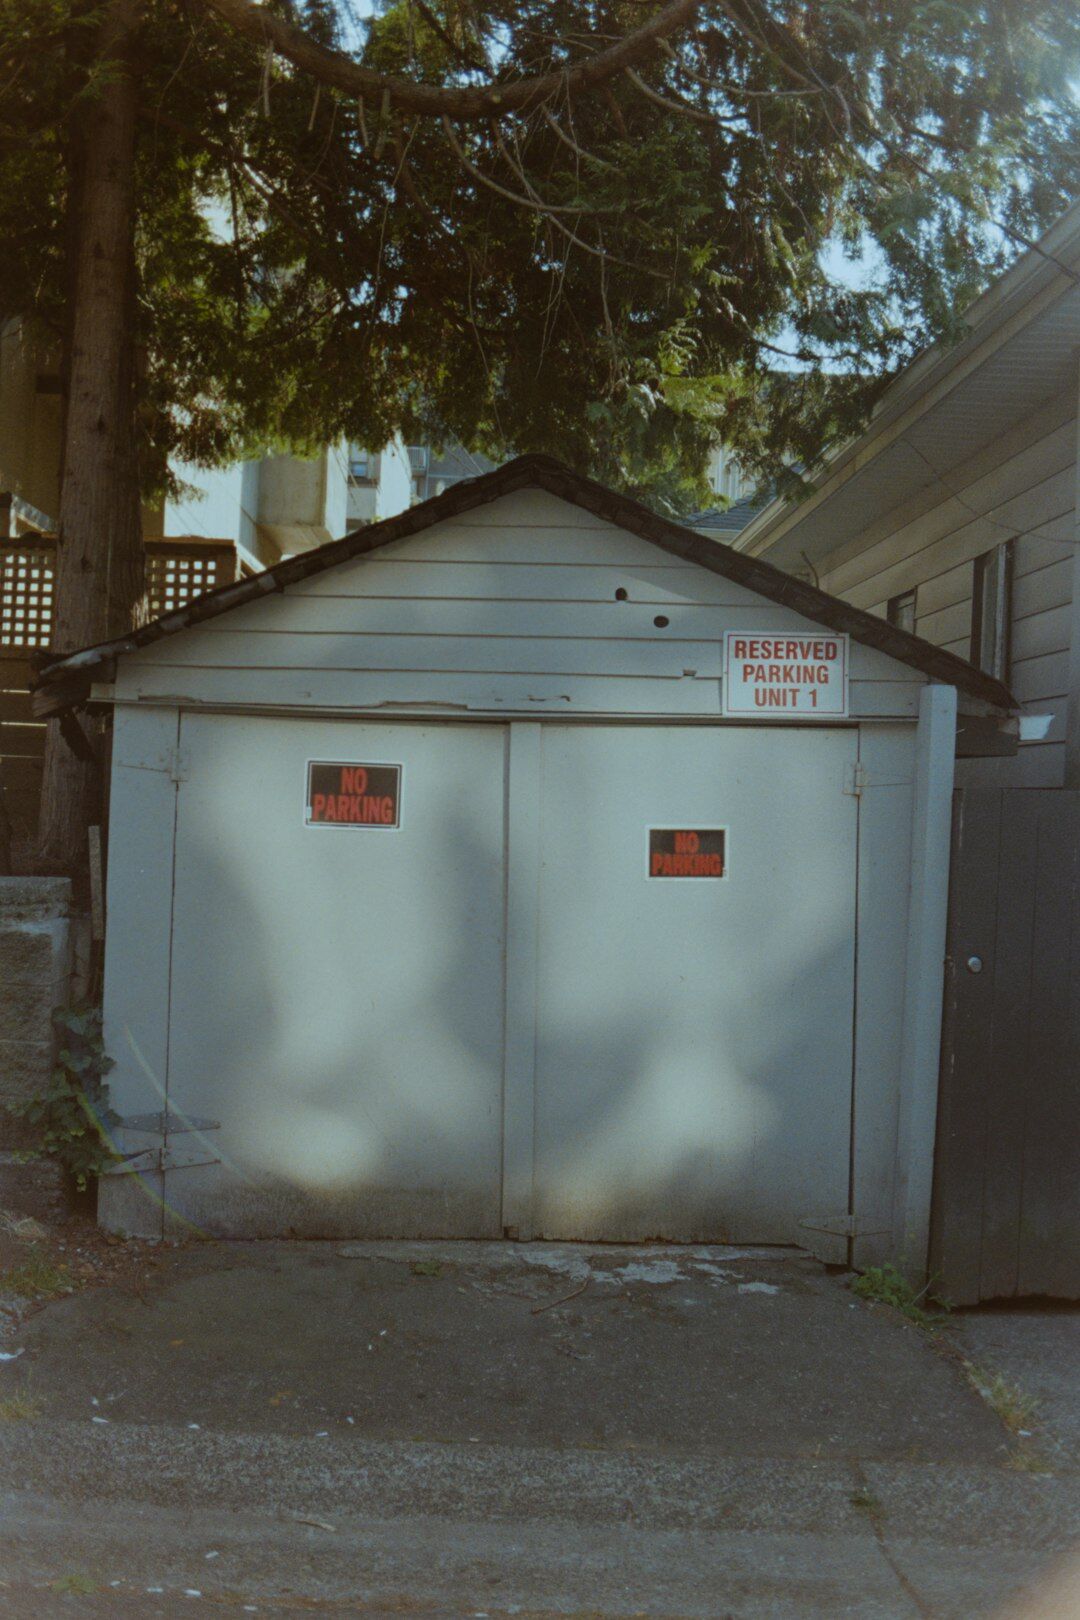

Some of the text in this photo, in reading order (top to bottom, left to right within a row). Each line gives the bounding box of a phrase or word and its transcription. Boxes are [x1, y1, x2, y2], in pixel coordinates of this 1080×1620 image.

[734, 640, 837, 660] RESERVED
[742, 664, 829, 684] PARKING
[754, 688, 817, 707] UNIT 1
[342, 767, 368, 794] NO
[312, 794, 393, 823] PARKING
[675, 831, 699, 854] NO
[652, 852, 721, 876] PARKING
